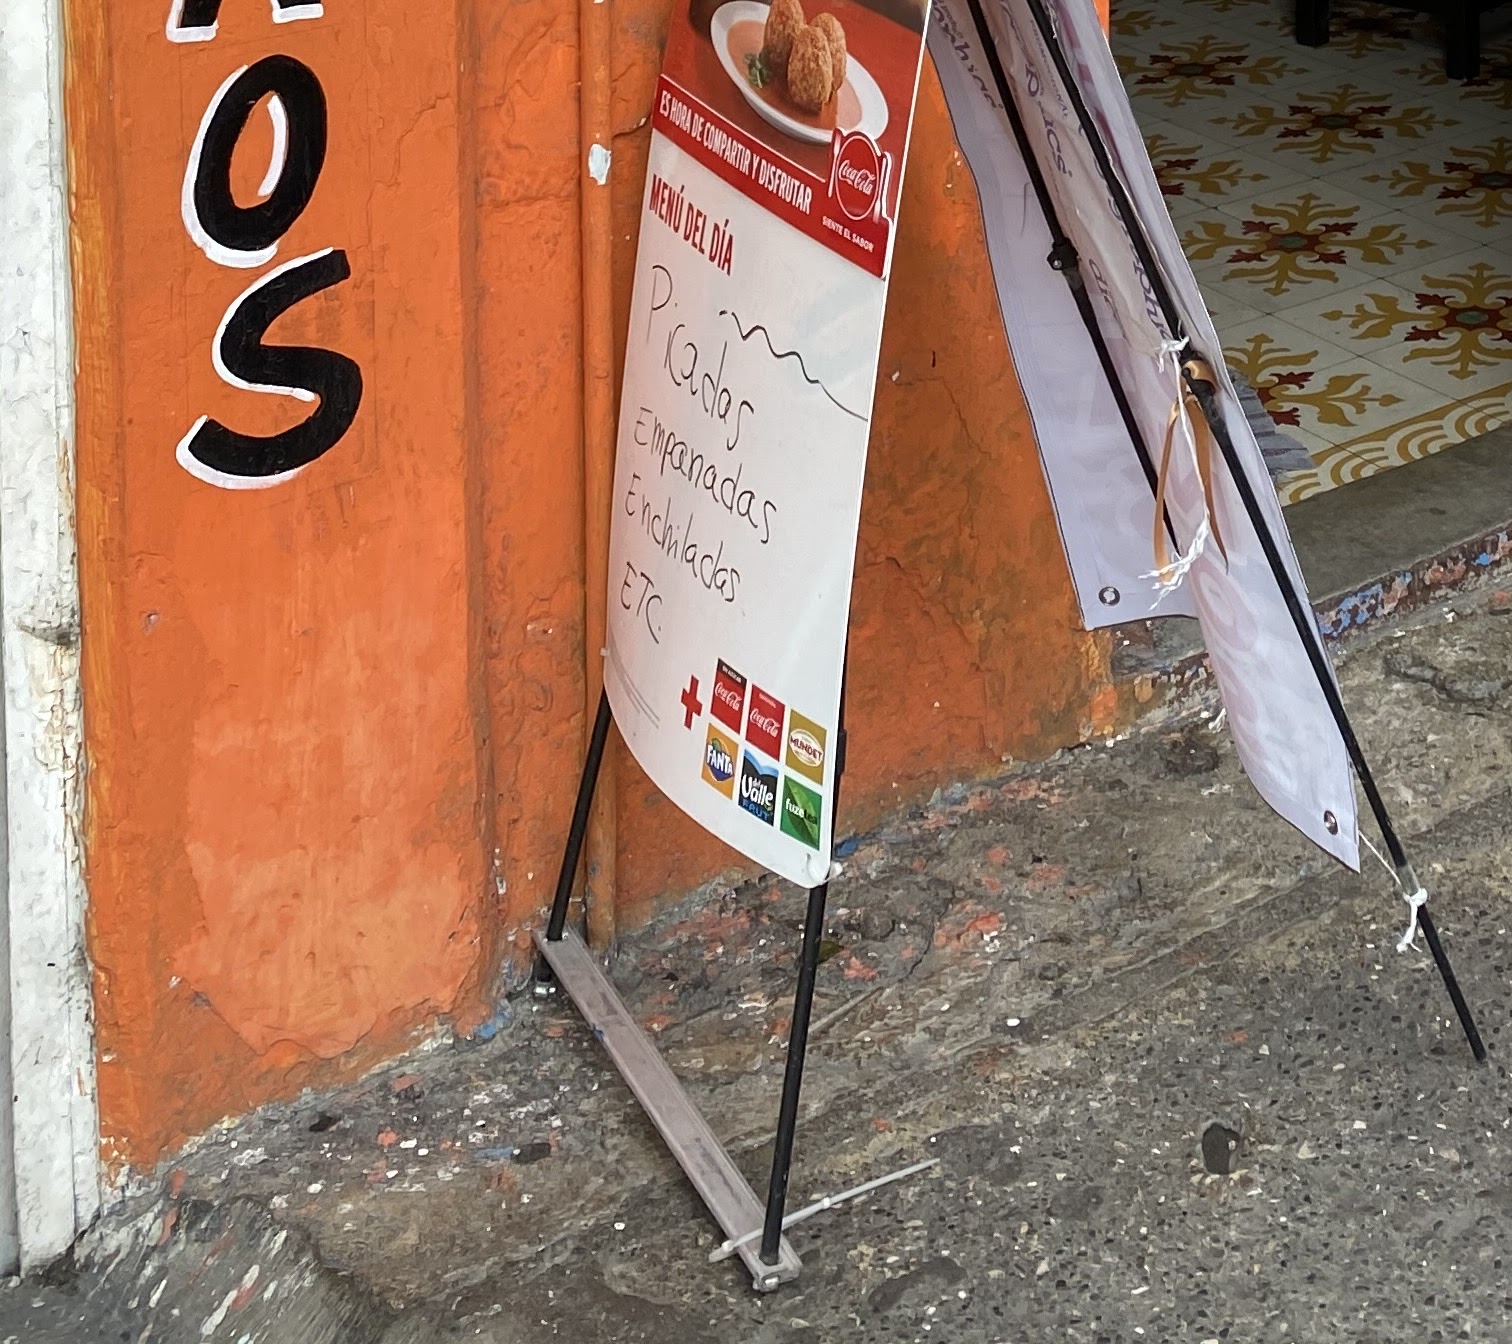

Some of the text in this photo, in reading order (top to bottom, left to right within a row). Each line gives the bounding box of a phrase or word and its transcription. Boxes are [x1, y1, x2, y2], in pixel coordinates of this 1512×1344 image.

[659, 90, 813, 215] ES HORA DE COMPARTIR Y DISFRUTAR
[649, 173, 735, 276] MENÚ DEL DÍA
[822, 215, 875, 253] SIENTE EL SABOR
[634, 407, 777, 544] Empanadas
[624, 474, 740, 603] Enchiladas
[706, 743, 735, 776] FANTA
[789, 736, 823, 762] MUNDET
[741, 774, 774, 807] Valle
